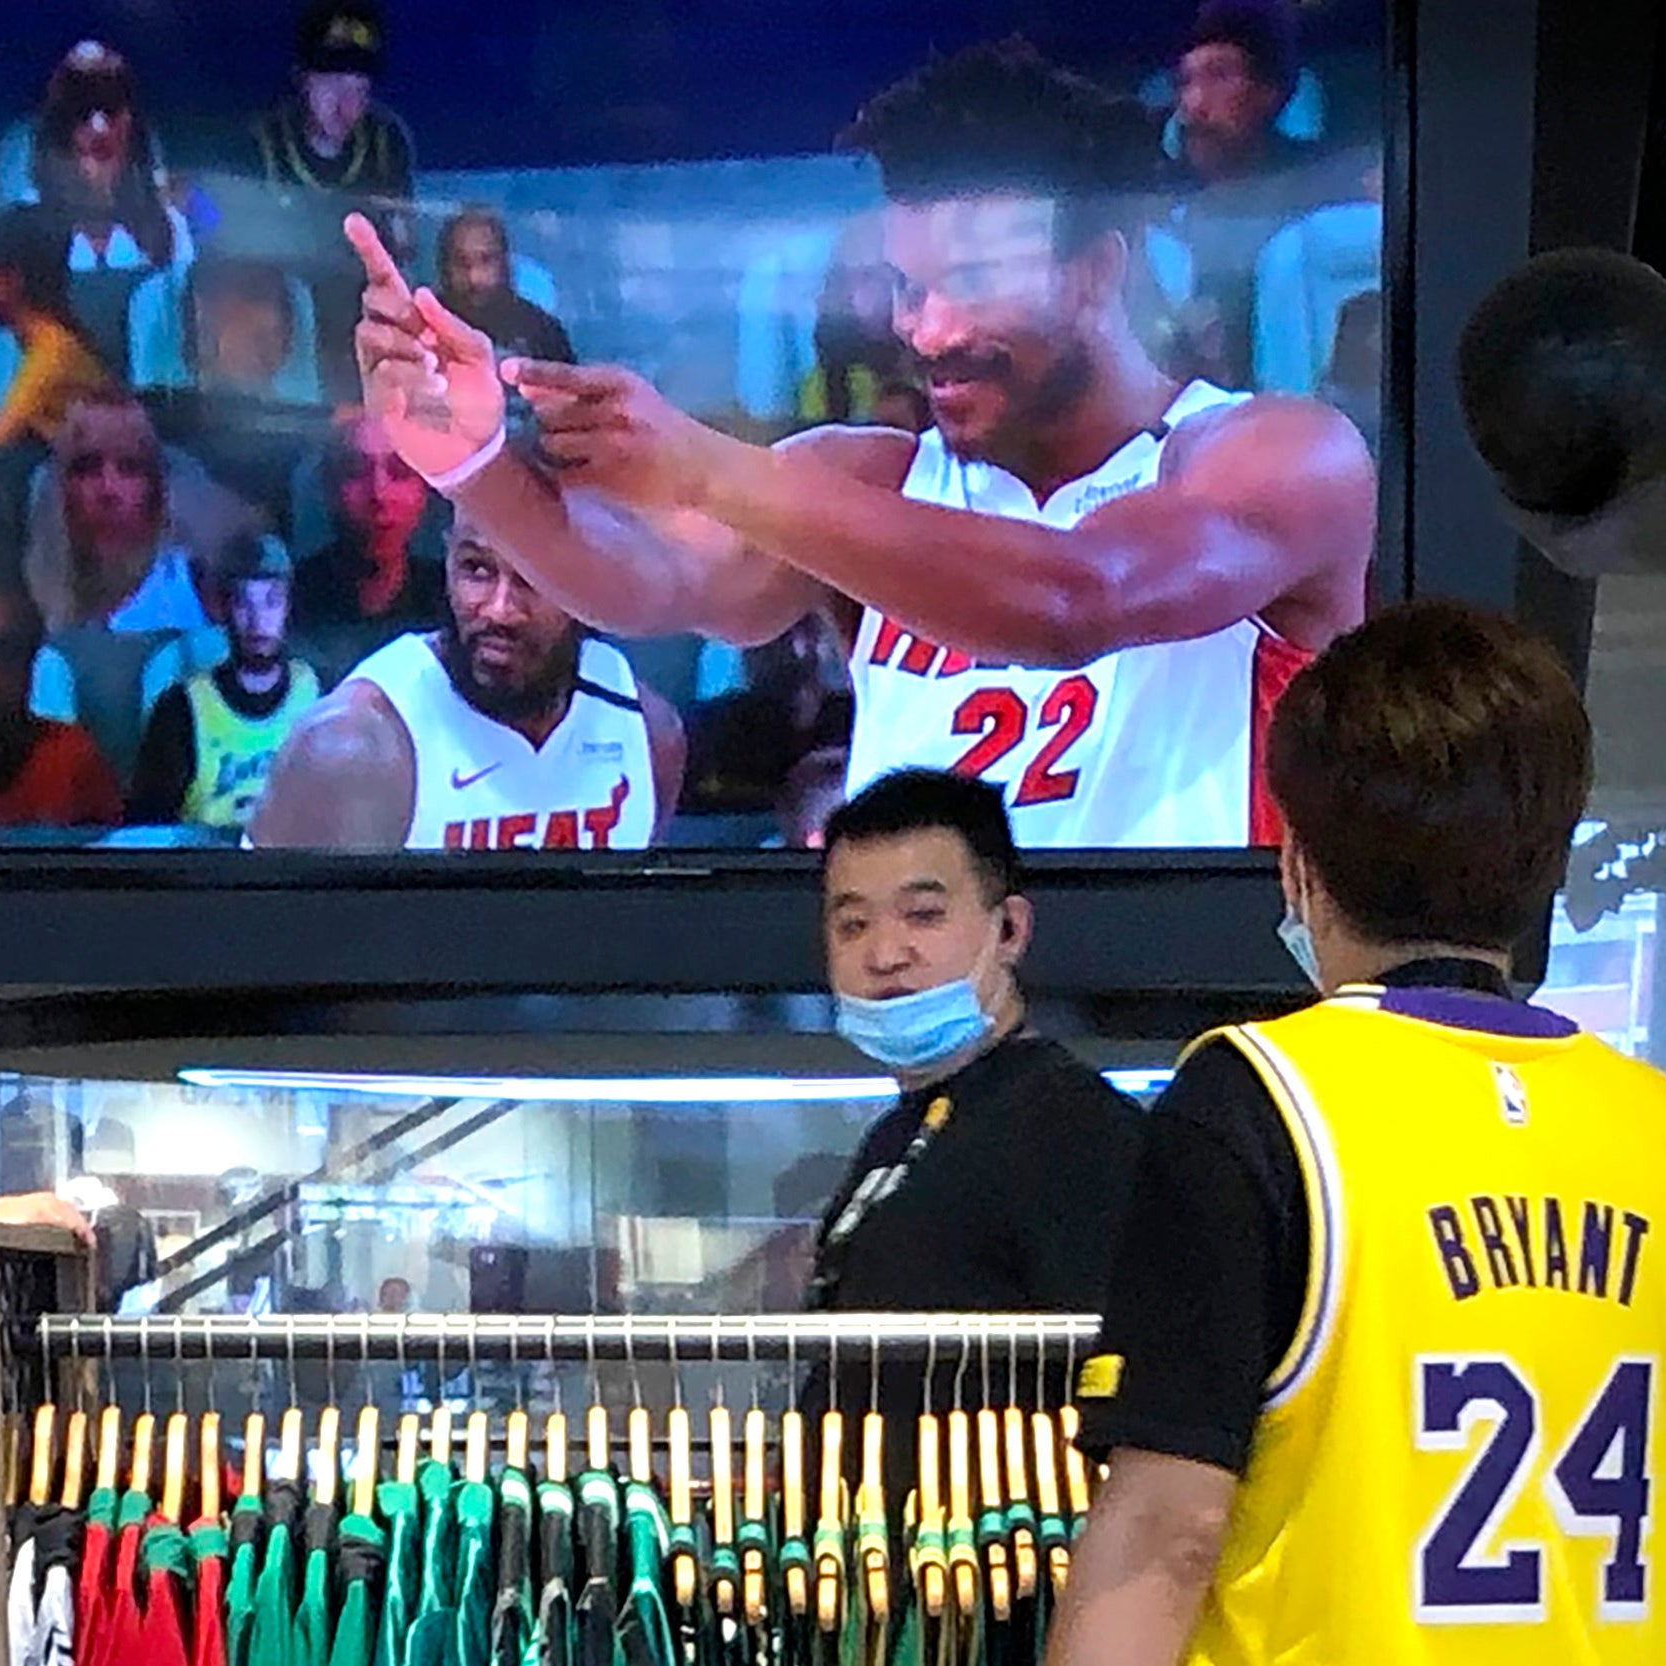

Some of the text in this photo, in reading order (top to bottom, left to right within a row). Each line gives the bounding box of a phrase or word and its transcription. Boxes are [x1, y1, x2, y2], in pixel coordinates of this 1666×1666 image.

[950, 673, 1100, 809] 22
[1428, 1194, 1650, 1307] BRYANT
[1414, 1353, 1657, 1625] 24
